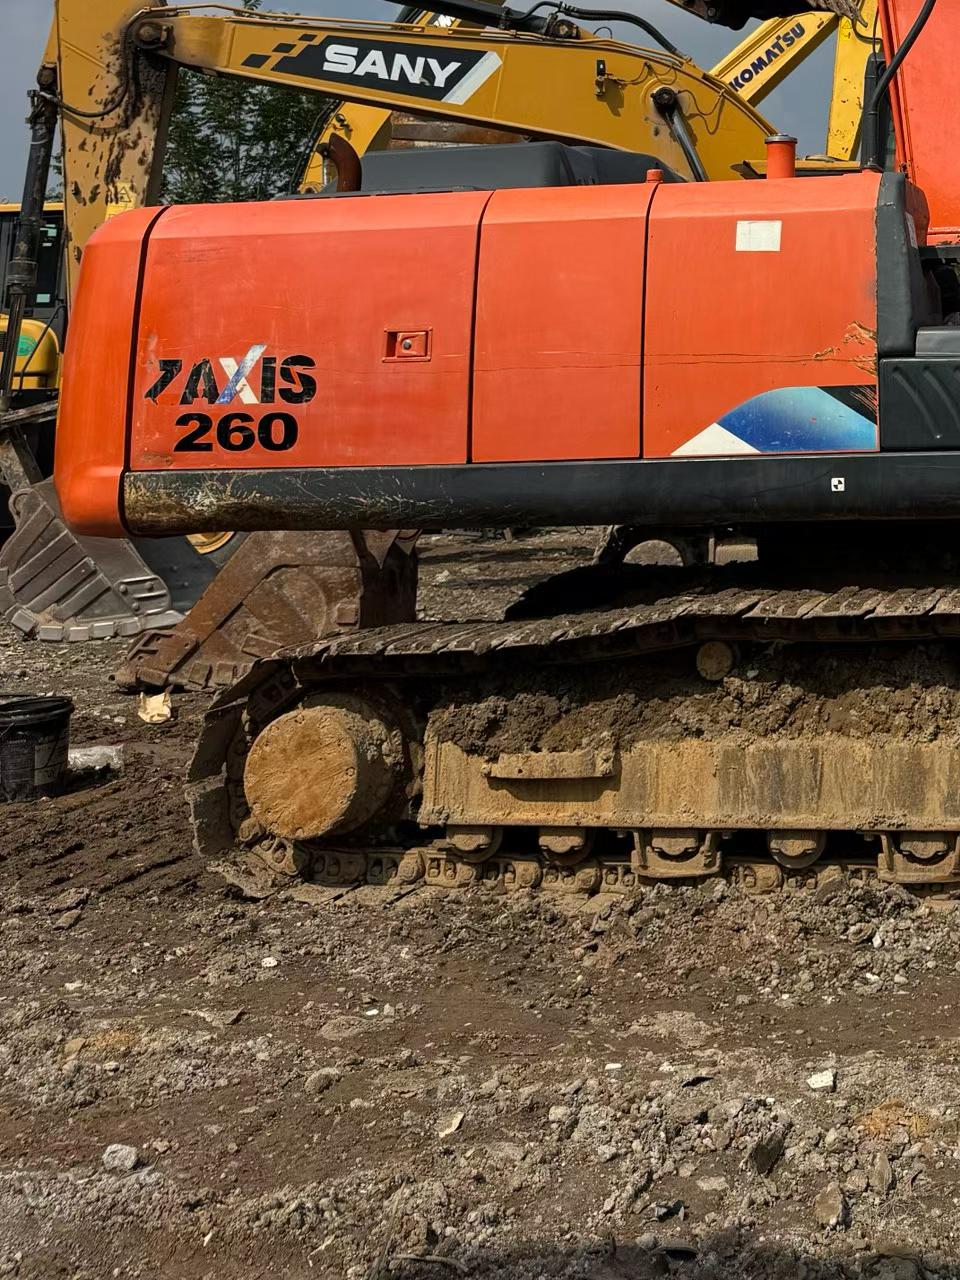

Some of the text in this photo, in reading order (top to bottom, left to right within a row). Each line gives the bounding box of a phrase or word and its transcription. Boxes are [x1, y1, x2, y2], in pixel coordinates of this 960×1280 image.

[323, 44, 462, 88] SANY
[728, 22, 806, 92] KOMATSU
[173, 412, 299, 452] 260
